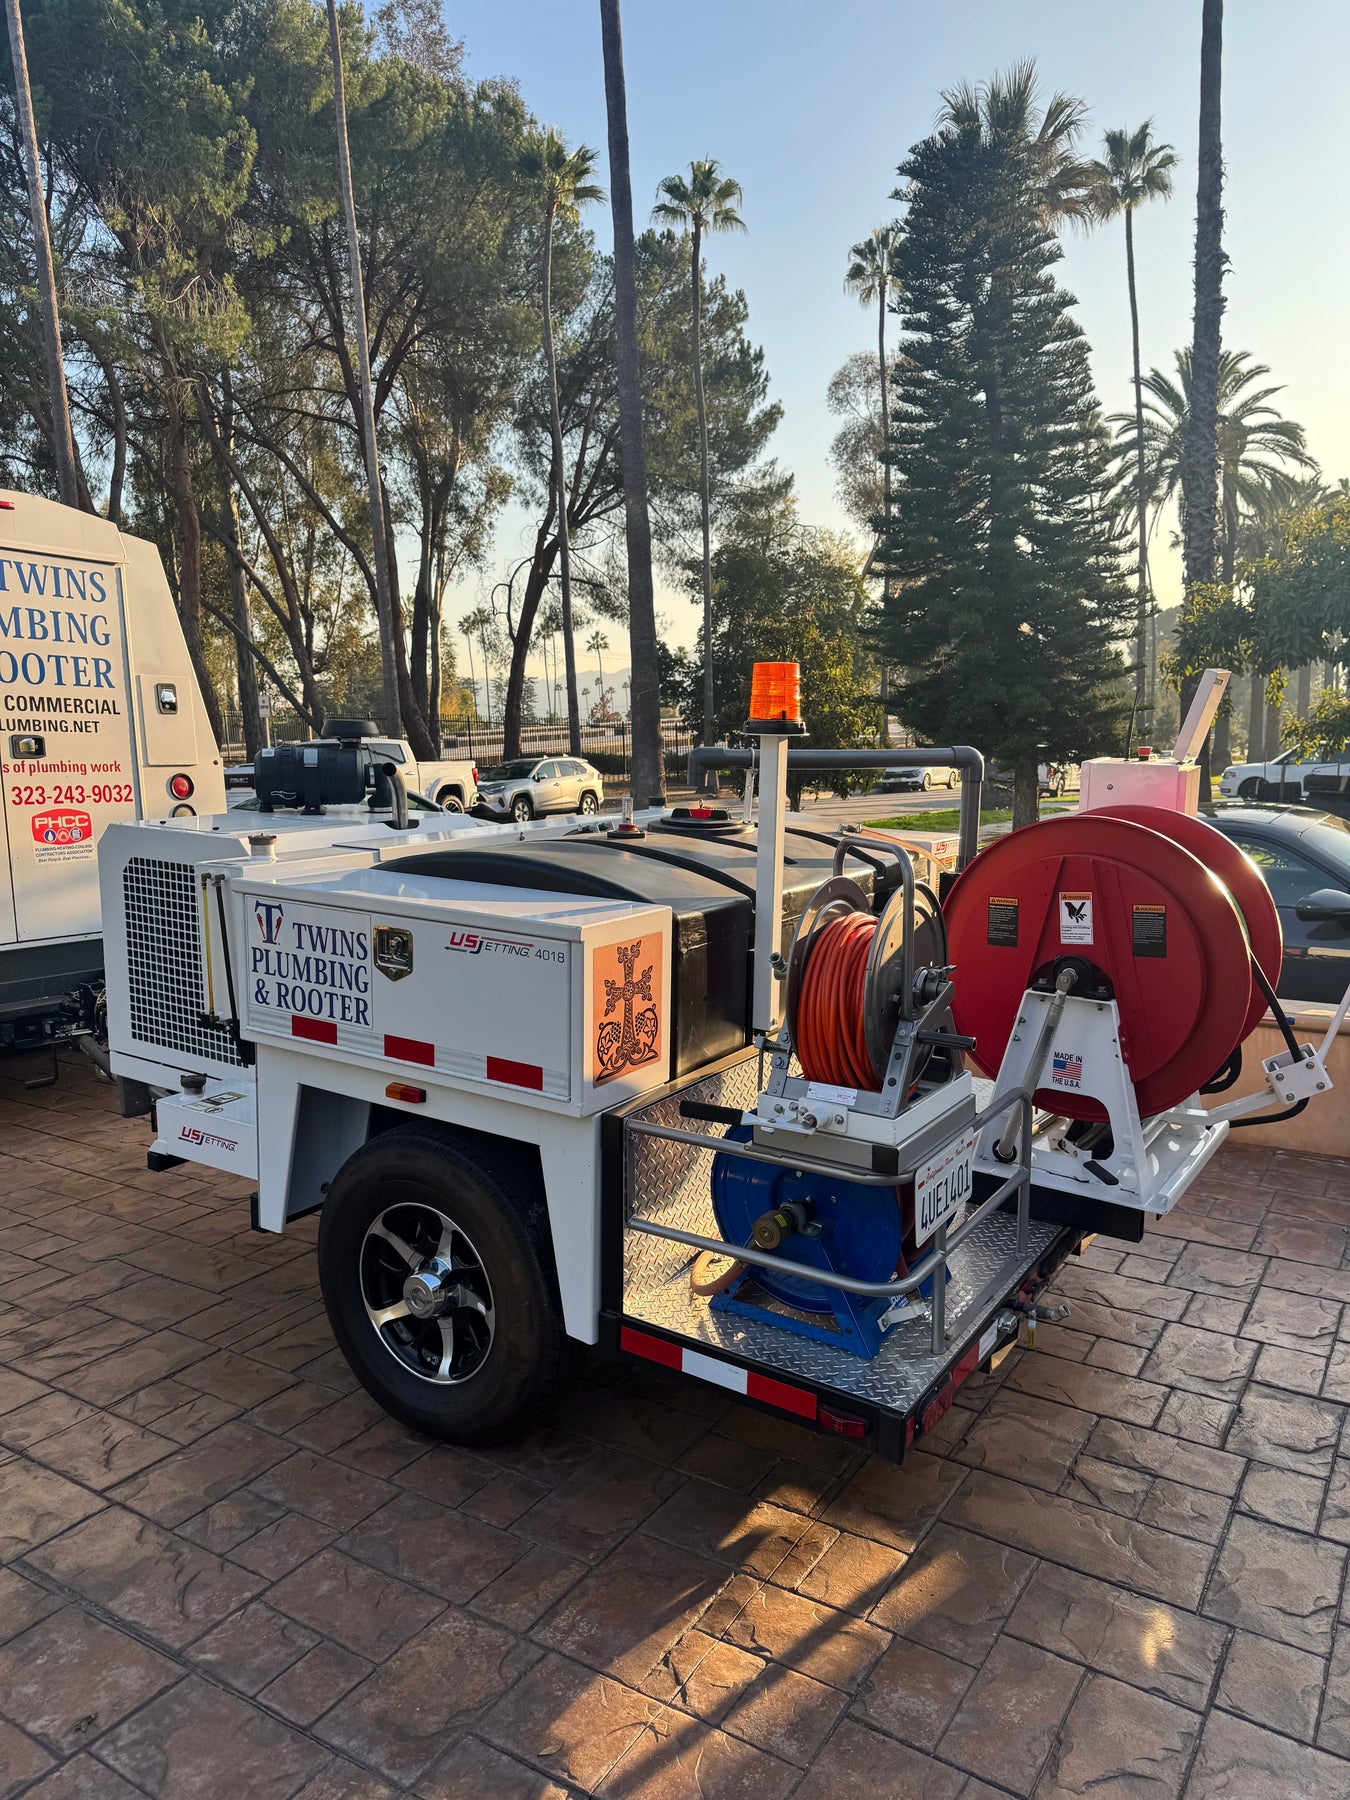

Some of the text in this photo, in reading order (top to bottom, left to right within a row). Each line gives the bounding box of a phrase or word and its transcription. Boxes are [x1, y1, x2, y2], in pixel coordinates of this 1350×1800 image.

[0, 559, 106, 602] TWINS
[0, 606, 110, 645] MBING
[0, 651, 115, 688] OOTER
[4, 695, 121, 715] COMMERCIAL
[0, 718, 100, 733] LUMBING.NET
[13, 760, 25, 773] of
[29, 760, 87, 776] plumbing
[90, 760, 121, 773] work
[11, 784, 134, 805] 323-243-9032
[34, 815, 89, 829] PHCC
[292, 922, 368, 961] TWINS
[535, 949, 565, 963] 4018
[251, 946, 369, 993] PLUMBING
[254, 978, 370, 1026] & ROOTER
[1054, 1051, 1082, 1063] MADE IN
[1052, 1076, 1063, 1085] THE
[921, 1158, 971, 1230] 4UE1401
